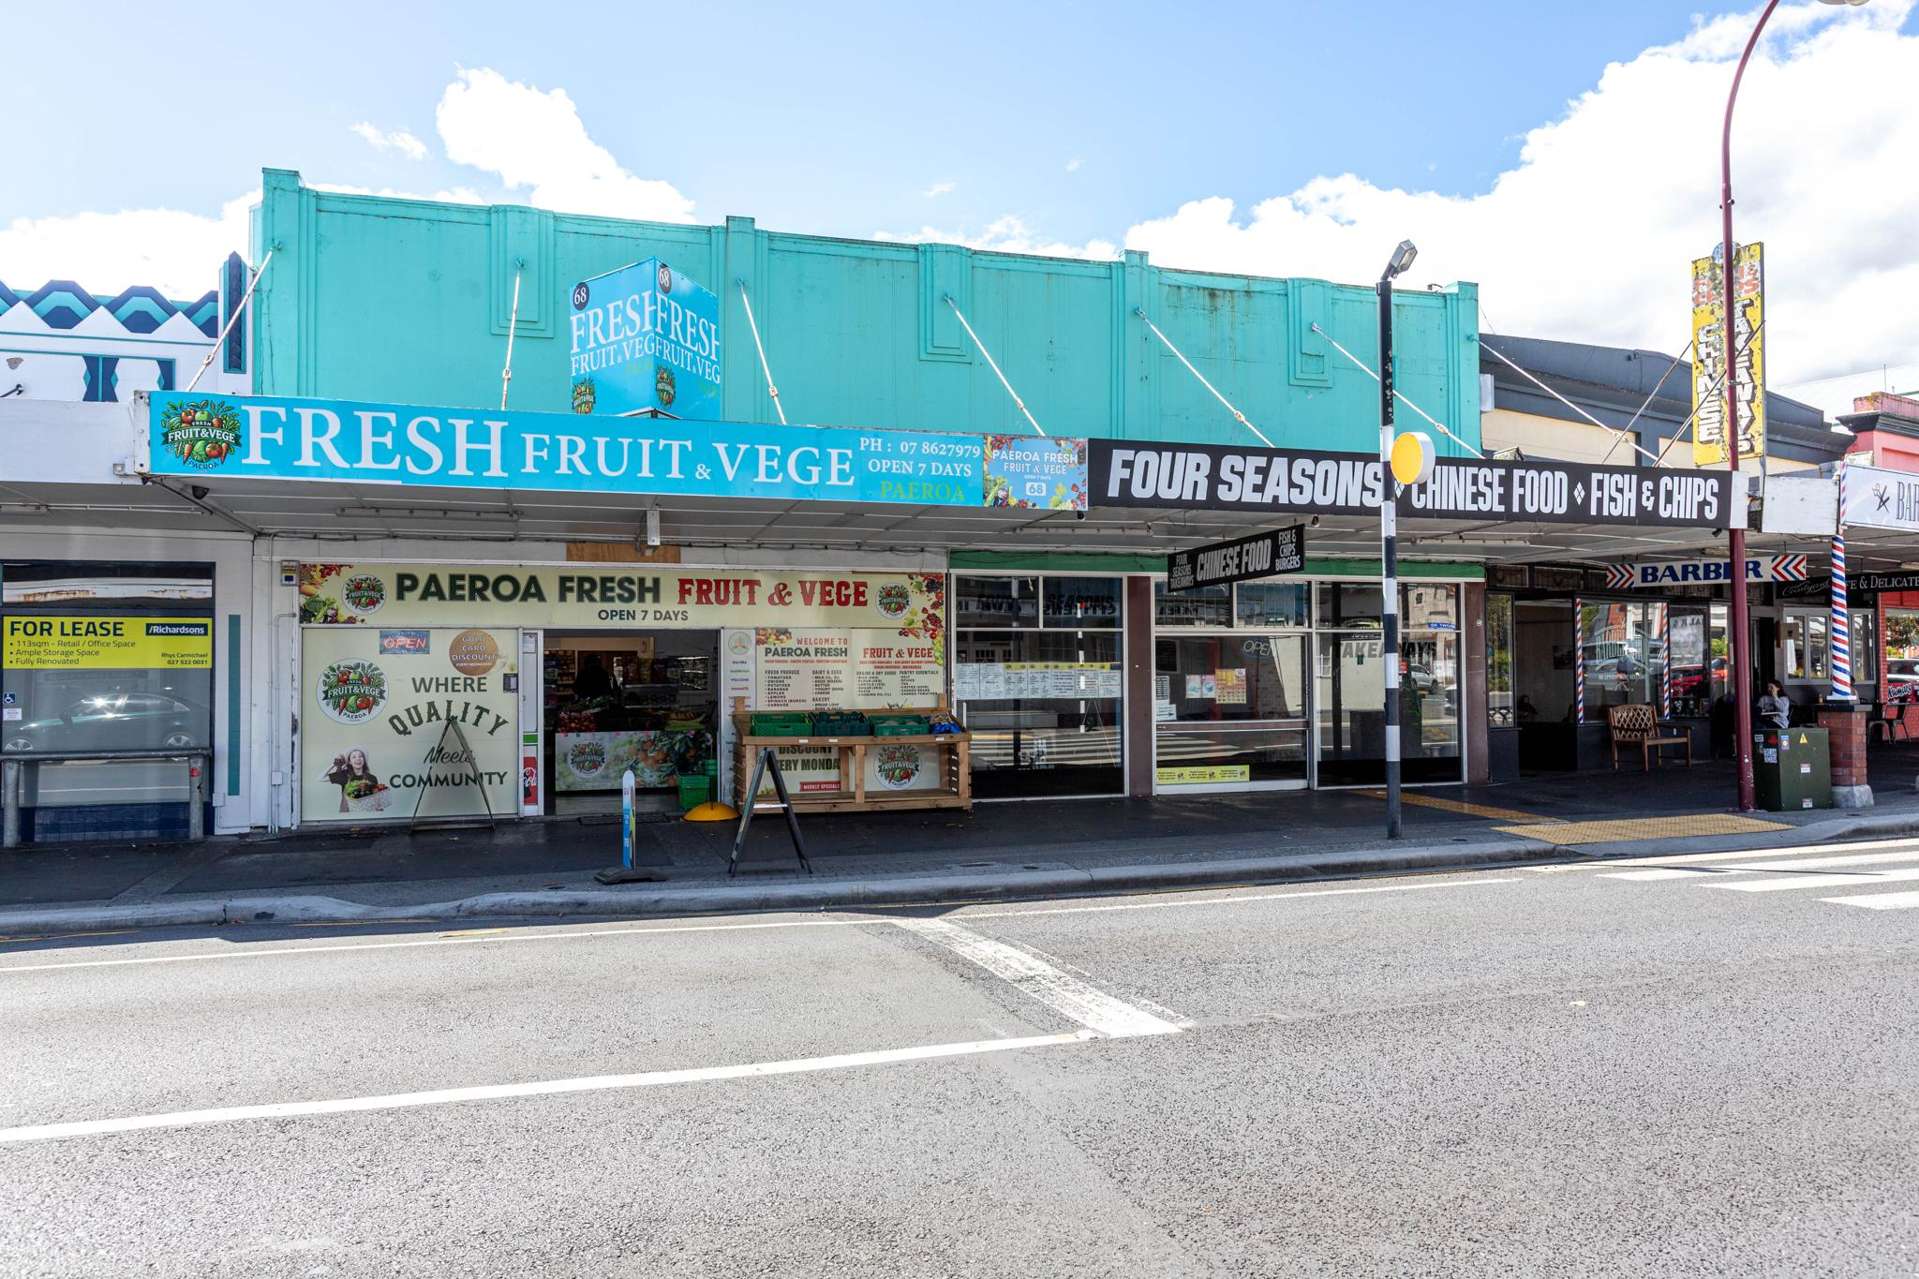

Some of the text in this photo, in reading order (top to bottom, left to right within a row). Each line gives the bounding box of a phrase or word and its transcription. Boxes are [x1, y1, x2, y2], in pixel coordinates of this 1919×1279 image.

[574, 287, 587, 305] 68
[571, 344, 618, 377] FRUIT
[656, 336, 693, 371] FRUIT
[168, 428, 236, 443] FRUIT&VEGE
[241, 404, 856, 487] FRESH FRUIT & VEGE
[860, 437, 882, 452] PH
[901, 441, 917, 455] 07
[922, 441, 981, 459] 8627979
[992, 450, 1078, 465] PAEROA FRESH
[868, 459, 972, 478] OPEN 7 DAYS
[1003, 462, 1031, 473] FRUIT
[1043, 464, 1067, 475] VEGE
[880, 480, 966, 501] PAEROA
[1028, 483, 1043, 494] 68
[1107, 449, 1719, 520] FOUR SEASONS CHINESE FOOD FISH & CHIPS
[1278, 530, 1291, 545] FISH
[1279, 543, 1296, 557] CHIPS
[1196, 539, 1272, 582] CHINESE FOOD
[1275, 555, 1301, 572] BURGERS
[395, 572, 868, 607] PAEROA FRESH FRUIT & VEGE
[1859, 575, 1868, 589] &
[598, 609, 688, 621] OPEN 7 DAYS
[10, 621, 125, 637] FOR LEASE
[16, 640, 50, 648] 113sqm
[112, 640, 136, 649] Space
[383, 635, 427, 649] OPEN
[796, 637, 848, 646] WELCOME TO
[15, 649, 100, 657] Ample Storage Space
[764, 647, 848, 657] PAEROA FRESH
[863, 648, 933, 658] FRUIT & VEGE
[15, 658, 35, 666] Fully
[327, 685, 381, 697] FRUIT&VEGE
[412, 676, 487, 693] WHERE
[388, 699, 509, 736] QUALITY
[801, 758, 840, 772] MONDA
[389, 771, 508, 789] COMMUNITY
